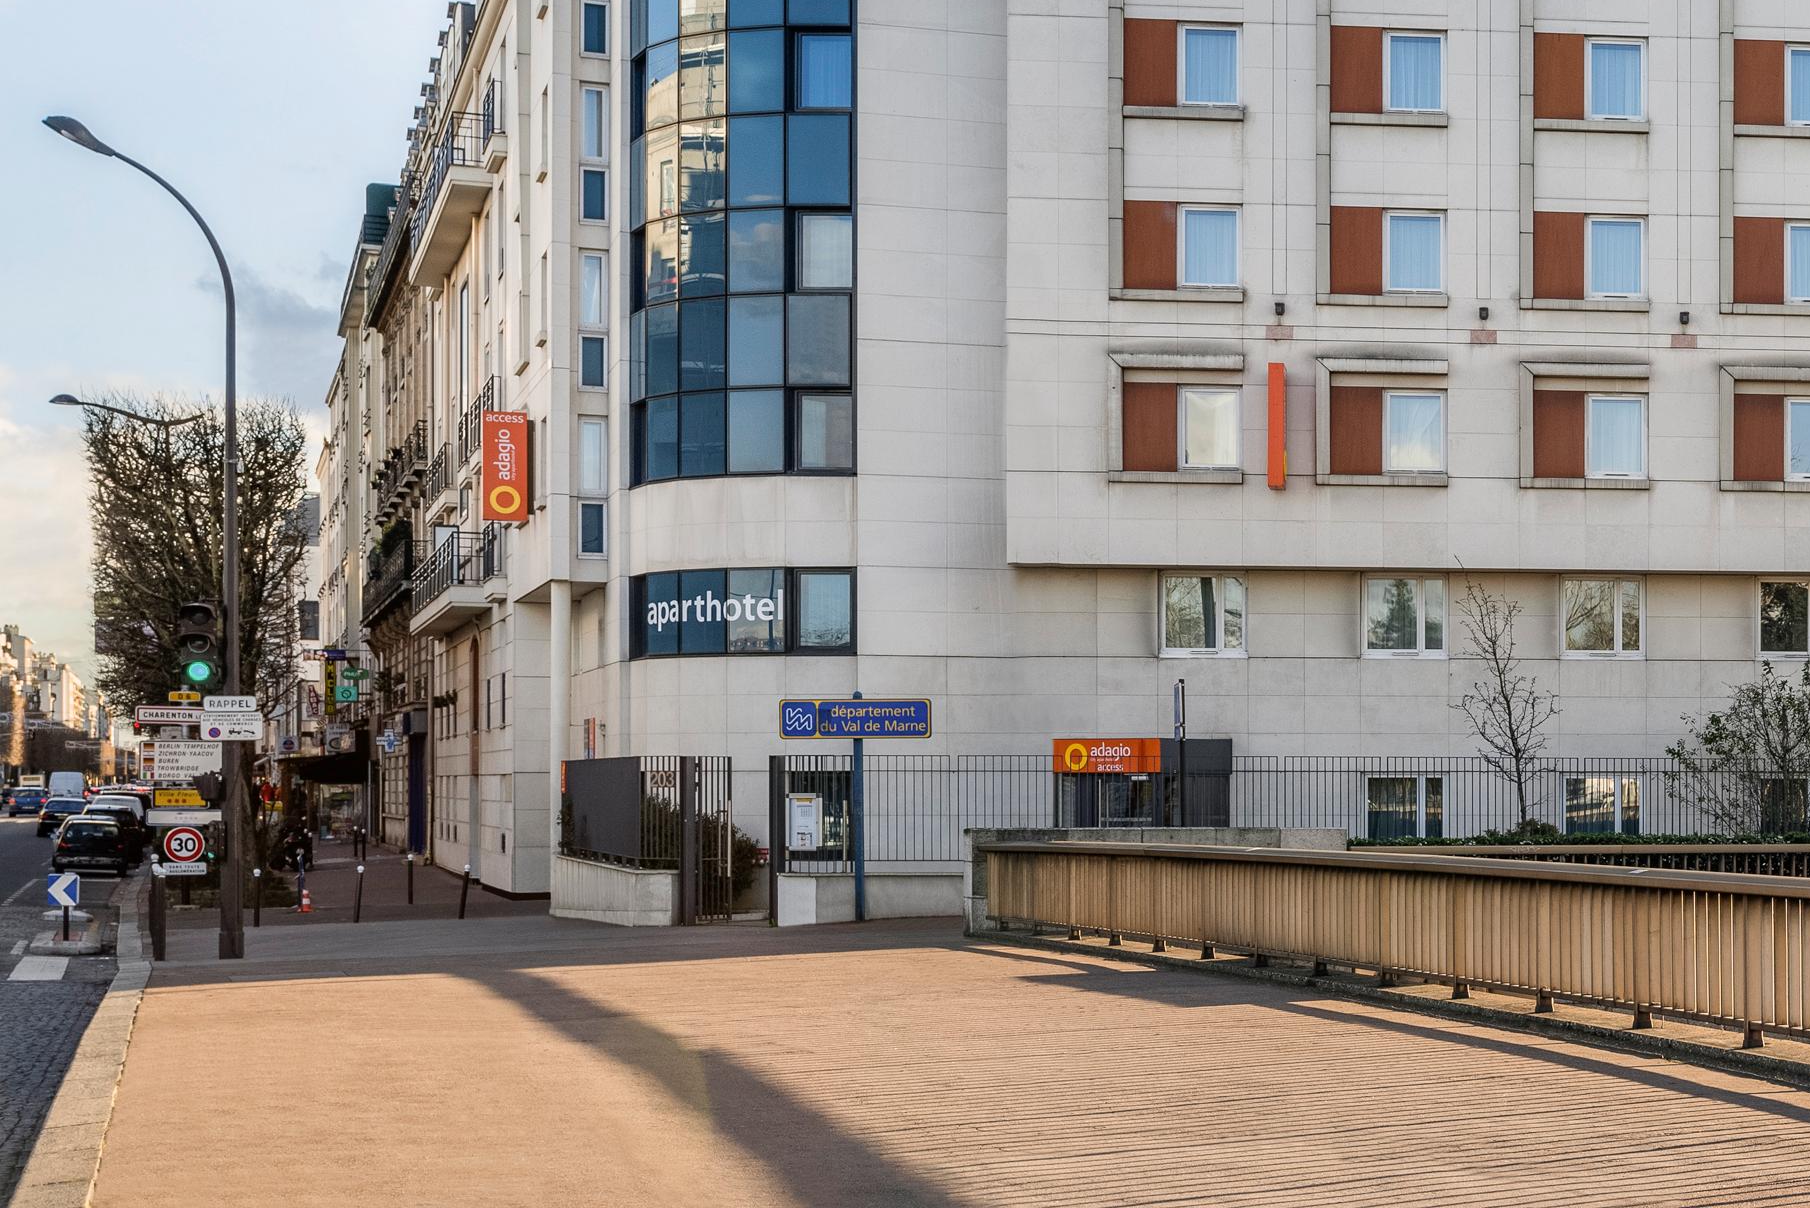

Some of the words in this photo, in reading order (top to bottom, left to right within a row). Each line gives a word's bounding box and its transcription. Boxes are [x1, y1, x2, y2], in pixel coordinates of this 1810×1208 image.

[485, 414, 524, 424] access
[493, 429, 516, 480] adagio
[647, 589, 784, 632] aparthotel
[209, 700, 251, 708] RAPPEL
[830, 705, 916, 719] département
[820, 720, 837, 732] du
[841, 720, 861, 732] Val
[864, 720, 881, 732] de
[884, 720, 927, 732] Marne
[1090, 741, 1131, 761] adagio
[1097, 763, 1124, 772] access
[650, 771, 675, 787] 203
[173, 837, 196, 852] 30
